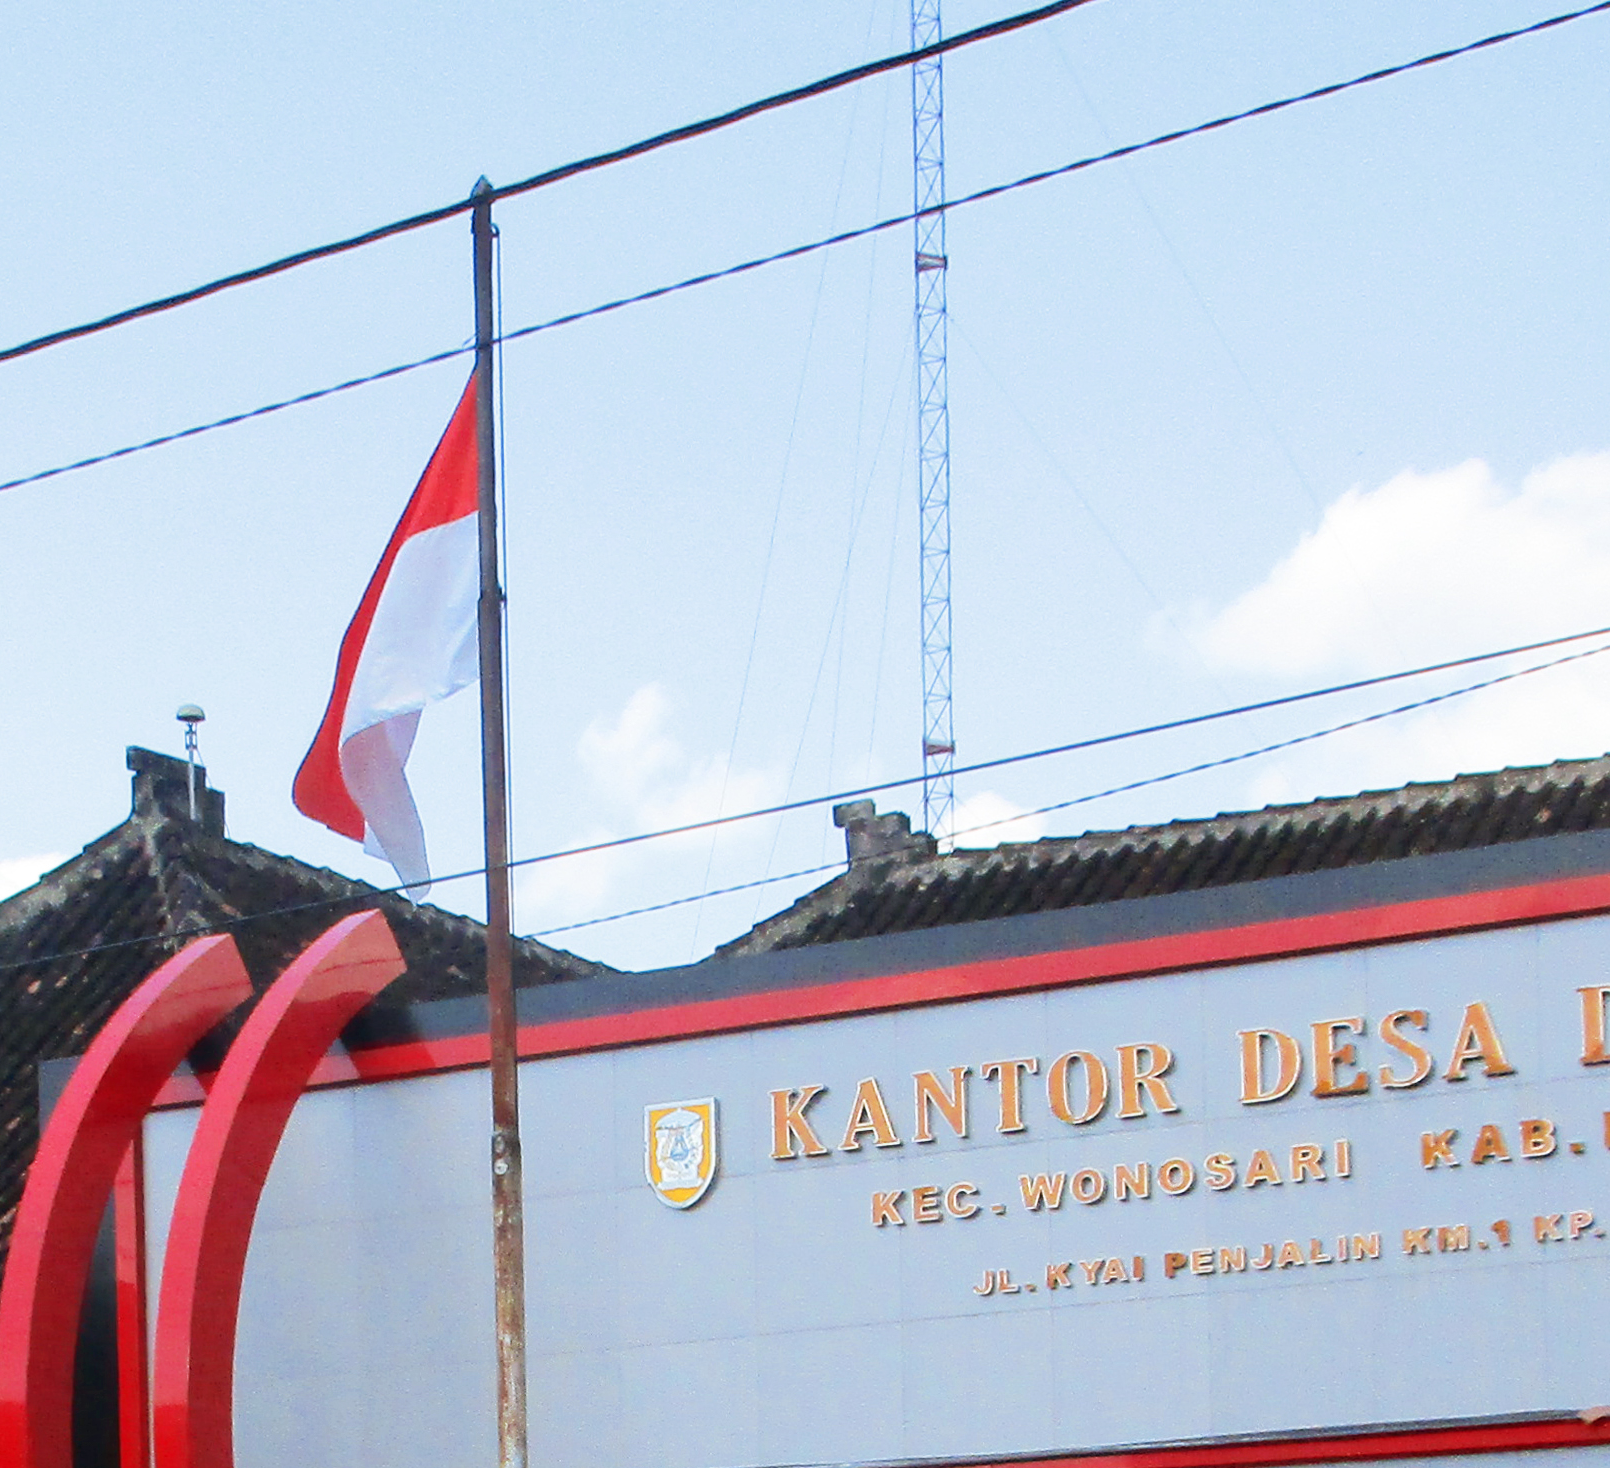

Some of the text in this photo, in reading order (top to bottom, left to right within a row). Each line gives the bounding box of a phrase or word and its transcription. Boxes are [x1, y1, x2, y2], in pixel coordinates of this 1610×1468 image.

[769, 1041, 1179, 1160] KANTOR
[1238, 1001, 1515, 1106] DESA
[1163, 1232, 1383, 1280] PENJALIN
